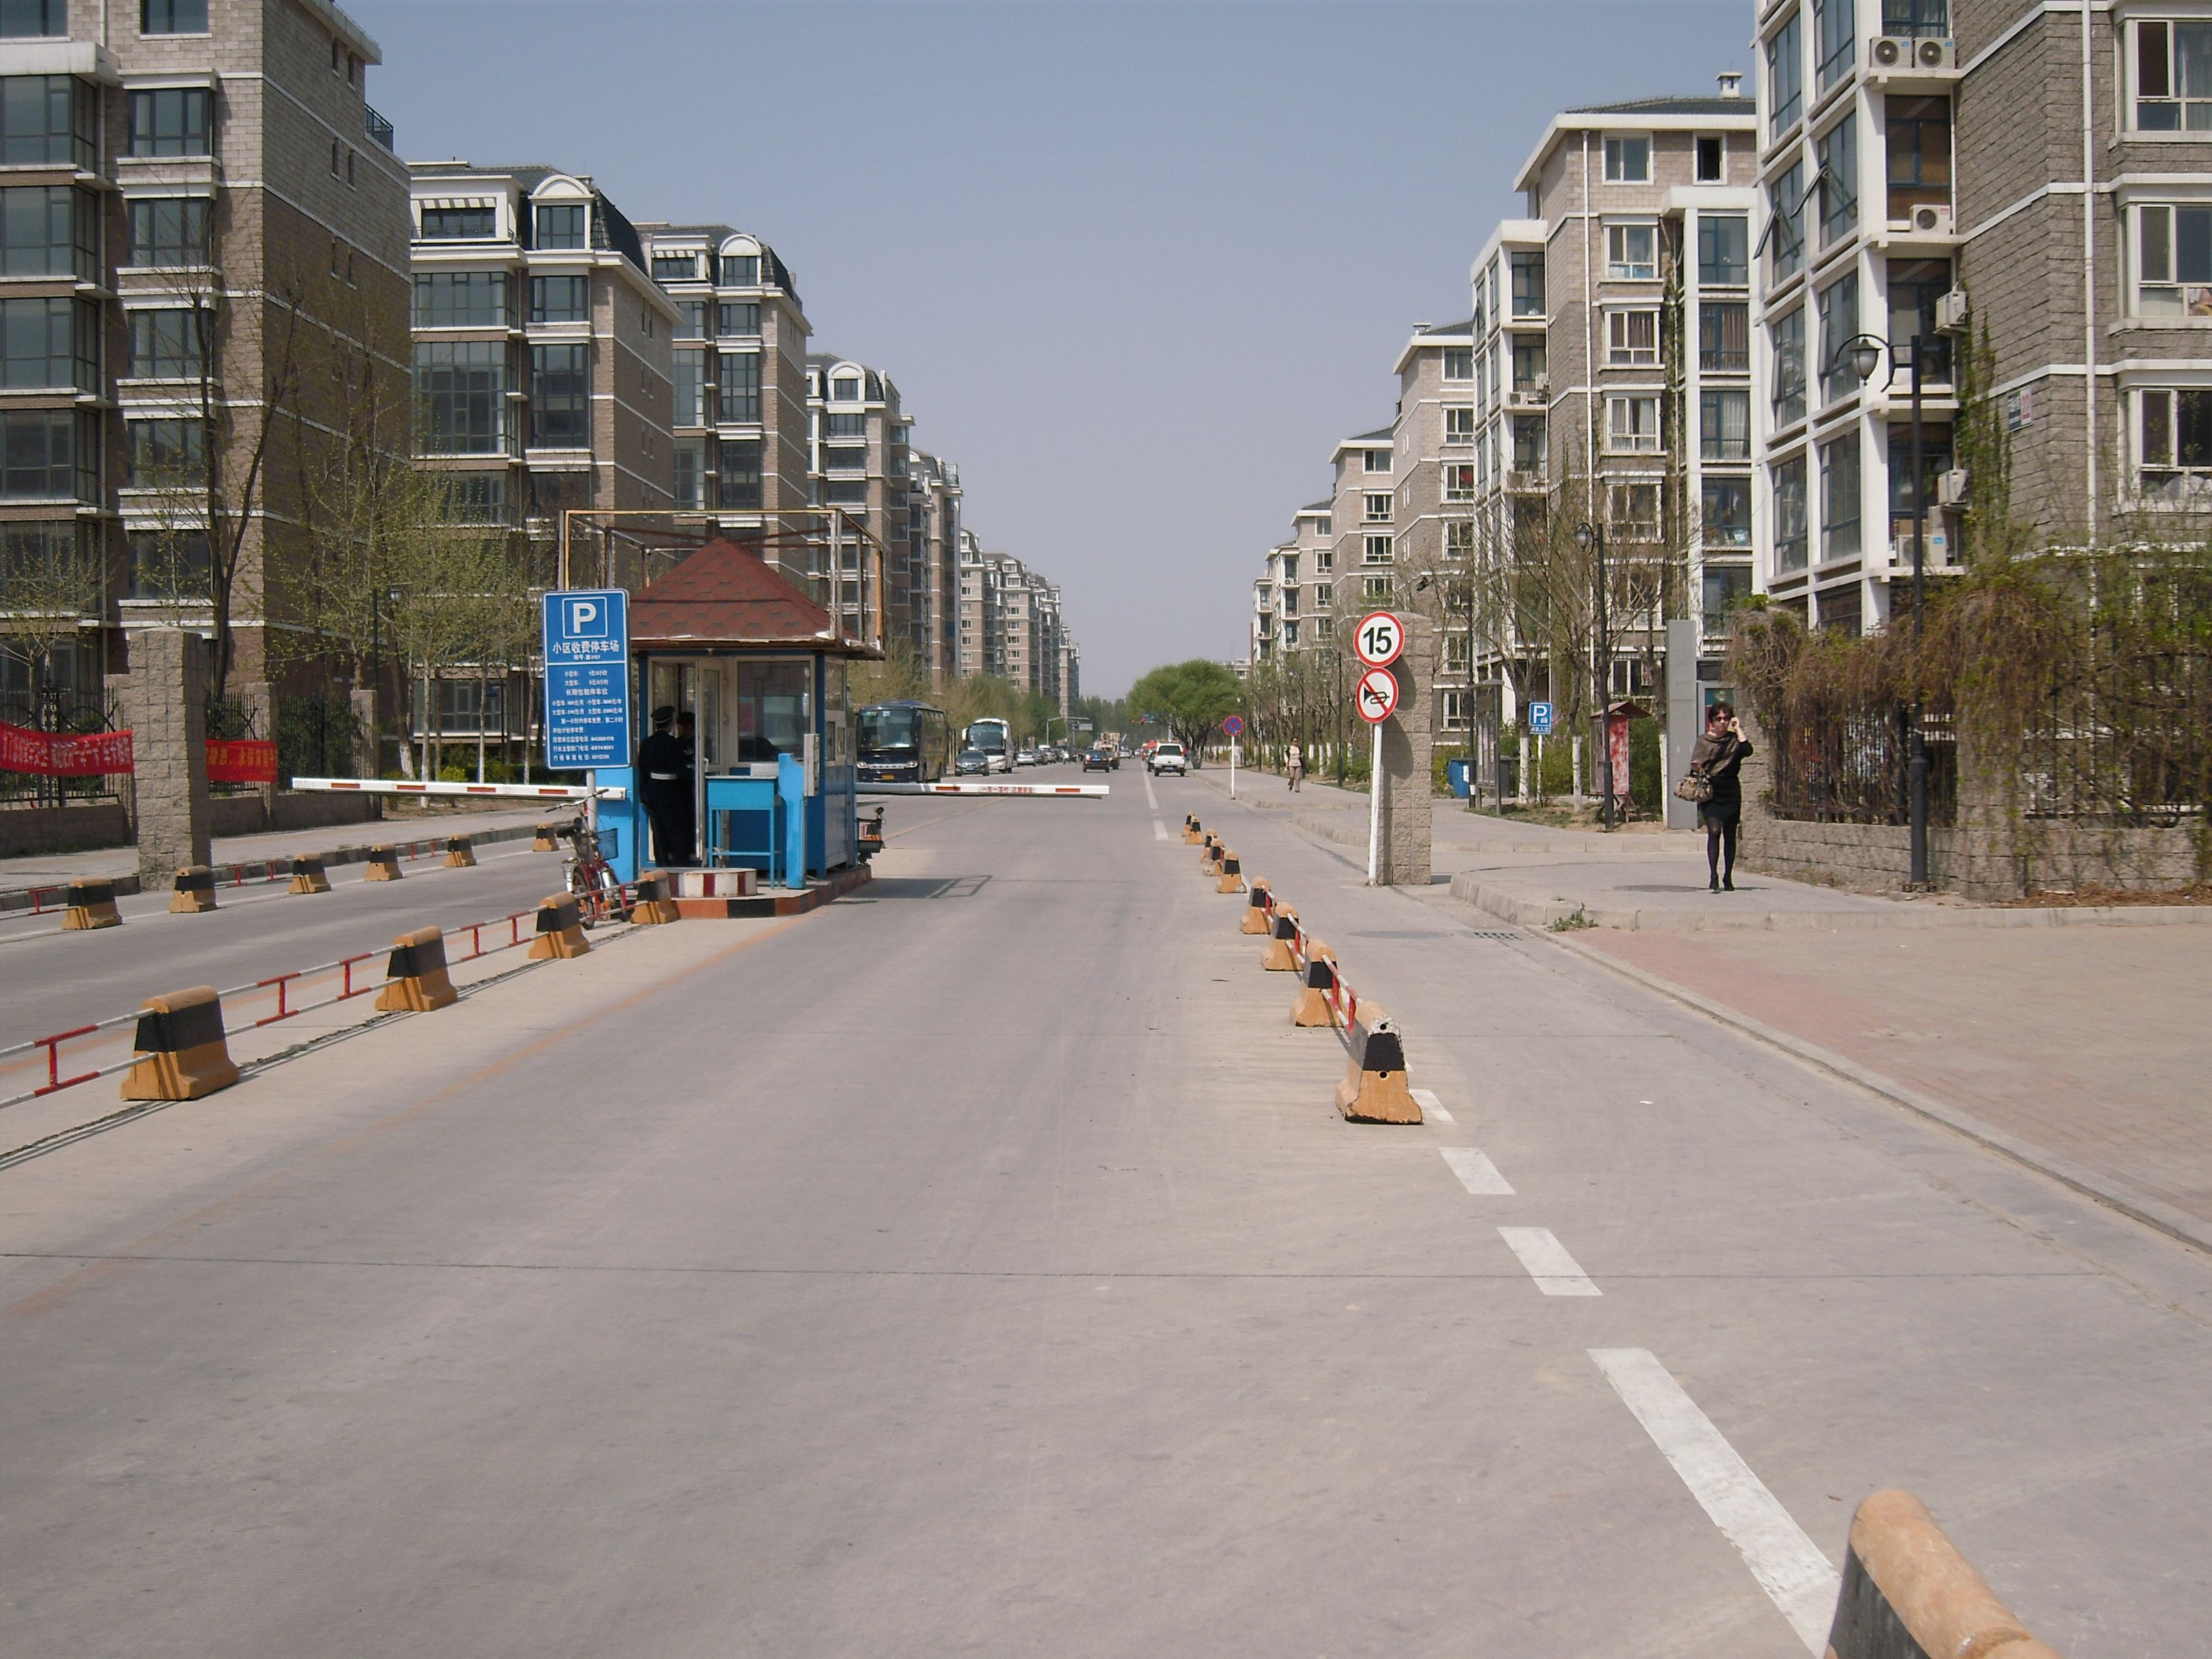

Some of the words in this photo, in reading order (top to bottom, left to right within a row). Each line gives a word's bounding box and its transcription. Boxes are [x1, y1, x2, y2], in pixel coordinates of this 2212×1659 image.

[573, 602, 596, 634] P
[552, 640, 619, 655] 小区收费停车场
[1363, 626, 1392, 655] 15
[566, 688, 608, 696] 长期包租停车位
[1533, 705, 1547, 724] P
